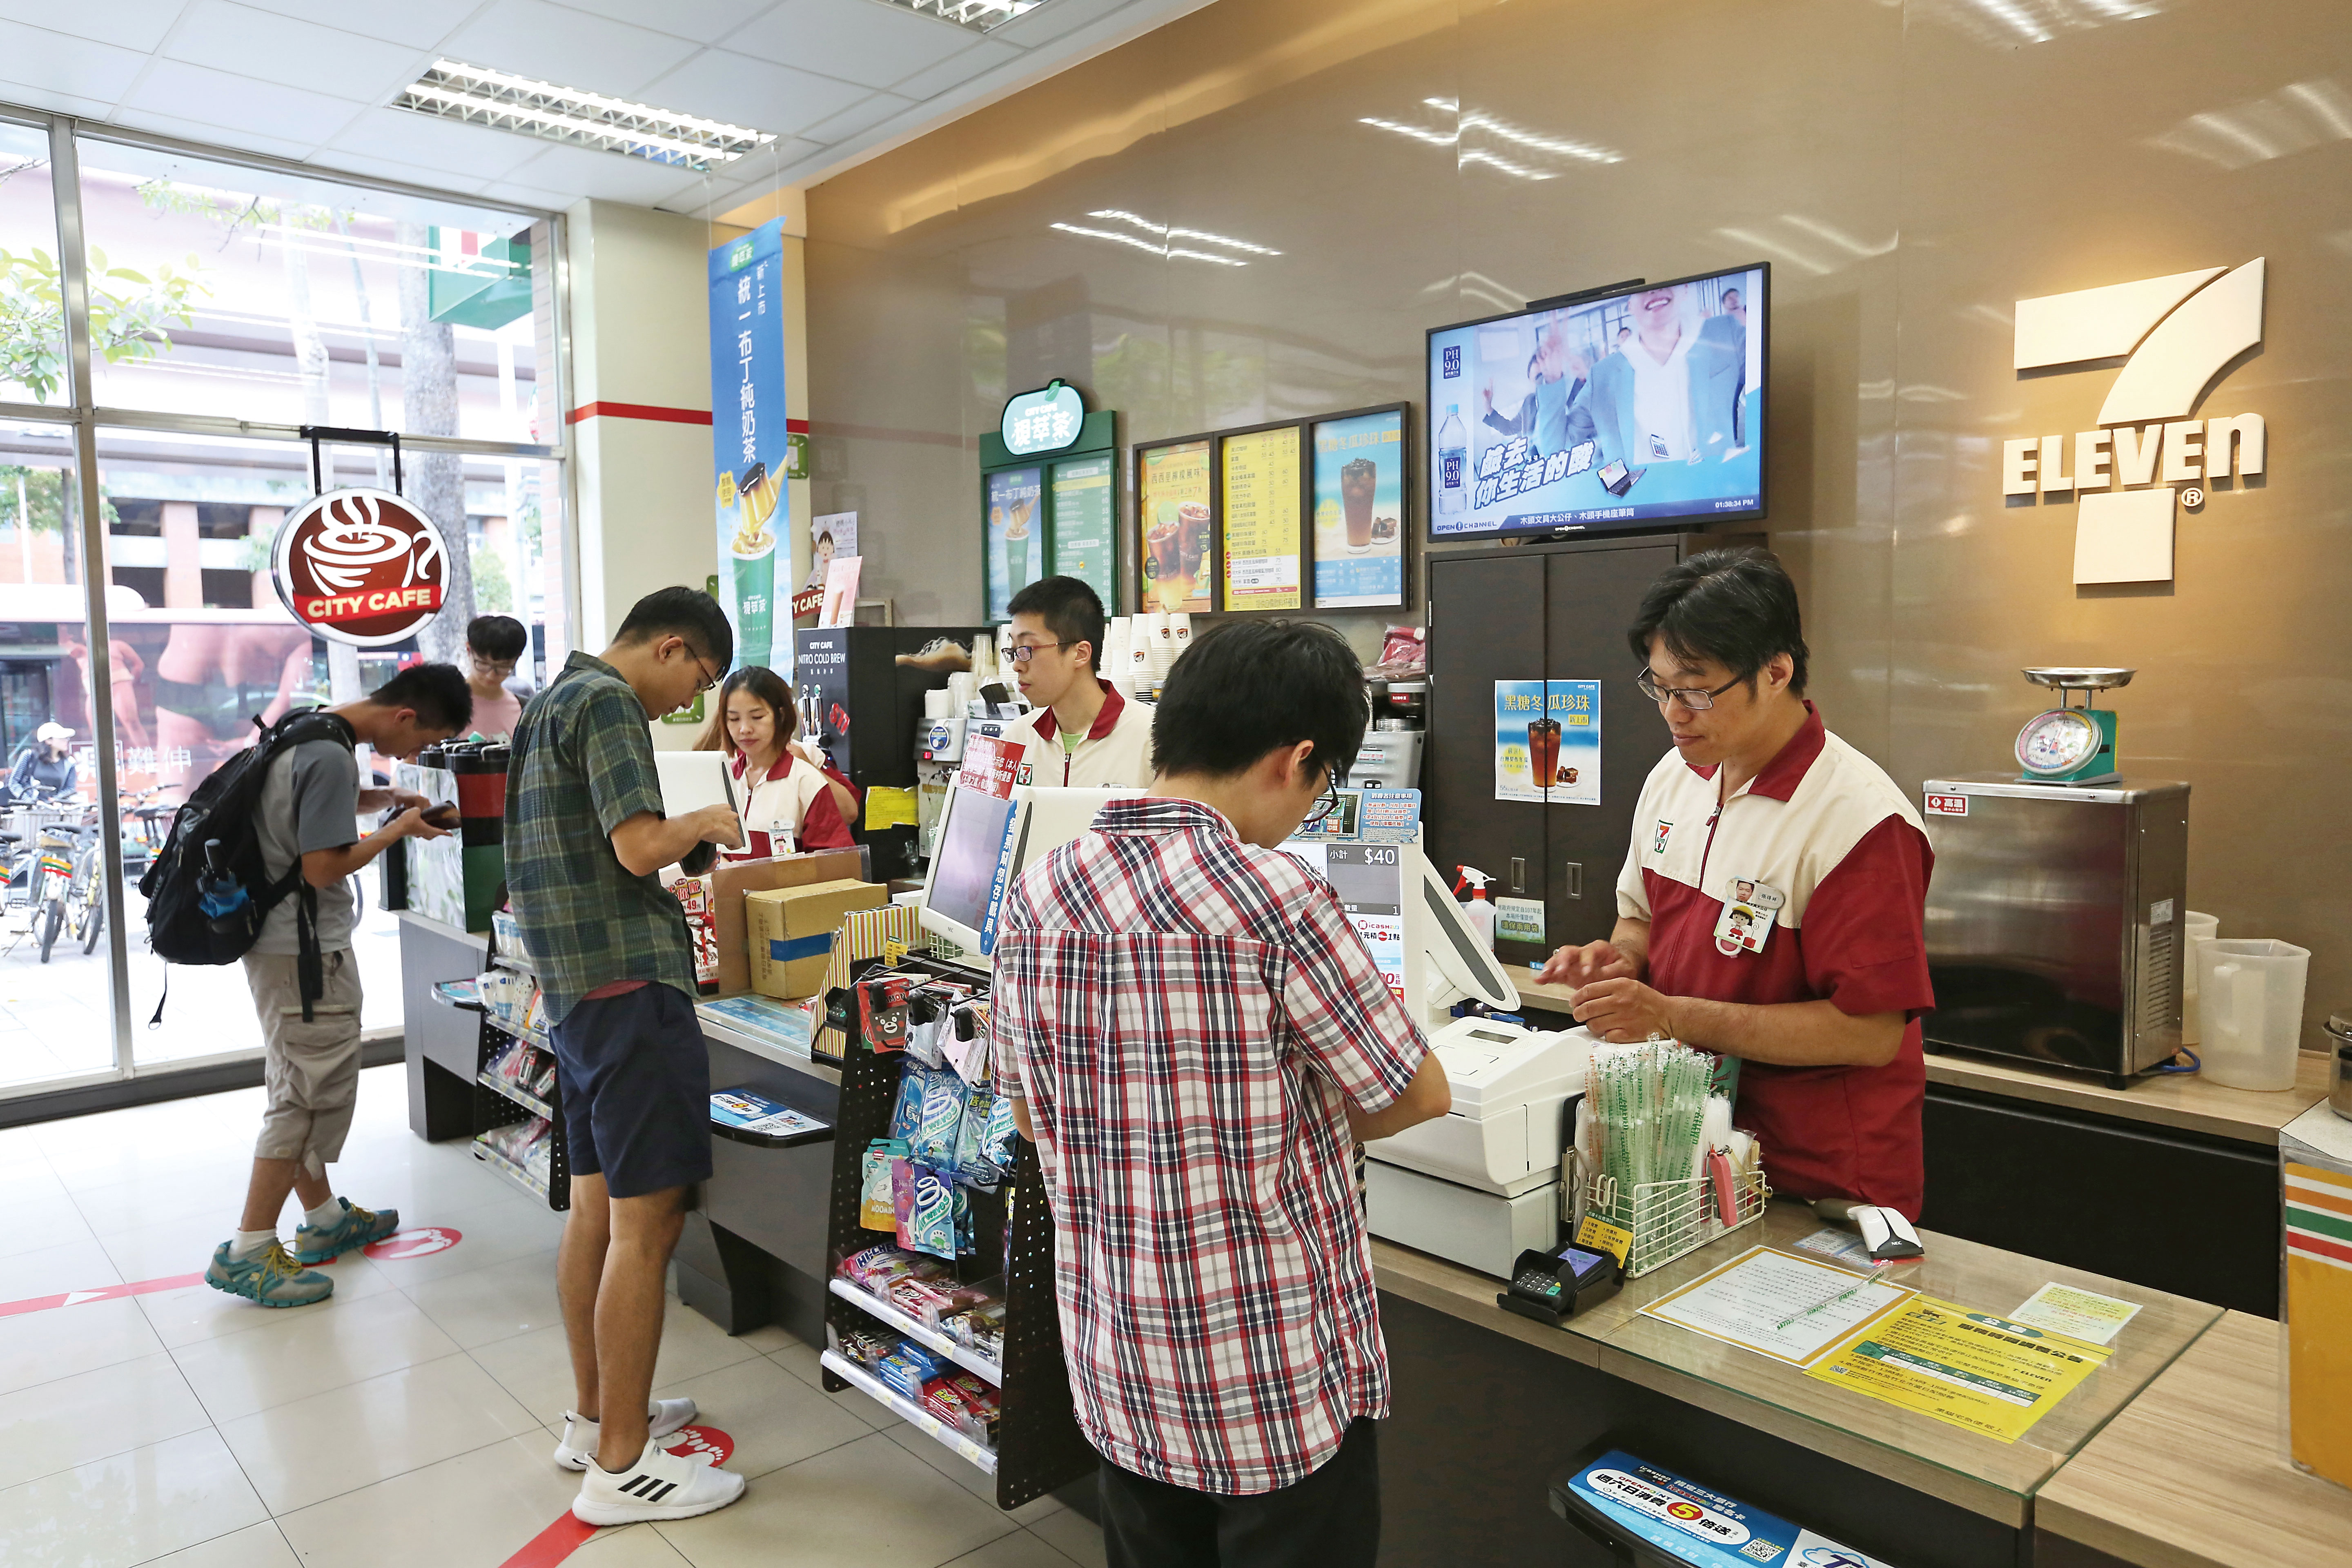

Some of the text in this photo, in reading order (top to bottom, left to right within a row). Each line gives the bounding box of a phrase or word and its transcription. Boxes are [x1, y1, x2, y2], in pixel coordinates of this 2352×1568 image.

[1446, 349, 1459, 360] PH
[737, 275, 756, 463] 統一布丁純奶茶
[1445, 359, 1459, 371] 9.0
[2014, 256, 2265, 584] 7
[1446, 461, 1459, 470] PH
[1479, 437, 1528, 479] 鹼去
[1446, 470, 1459, 481] 9.0
[1474, 440, 1595, 510] 你生活的酸
[1715, 500, 1742, 508] 01:38:34
[307, 588, 432, 618] CITY CAFE
[800, 593, 823, 612] CAFE
[809, 641, 833, 650] CITY CAFE
[798, 653, 846, 665] NITRO COLD BREW
[1504, 694, 1590, 712] 黑糖冬瓜珍珠
[1330, 846, 1395, 866] 小計 $40
[983, 817, 1016, 935] 發票幫您存載具
[1393, 906, 1399, 915] 1
[871, 1205, 895, 1214] MOOMIN
[1674, 1479, 1738, 1508] 指定三大銀行
[1595, 1473, 1732, 1536] 週六日消費 5 倍送
[1712, 1503, 1746, 1520] 聯名卡
